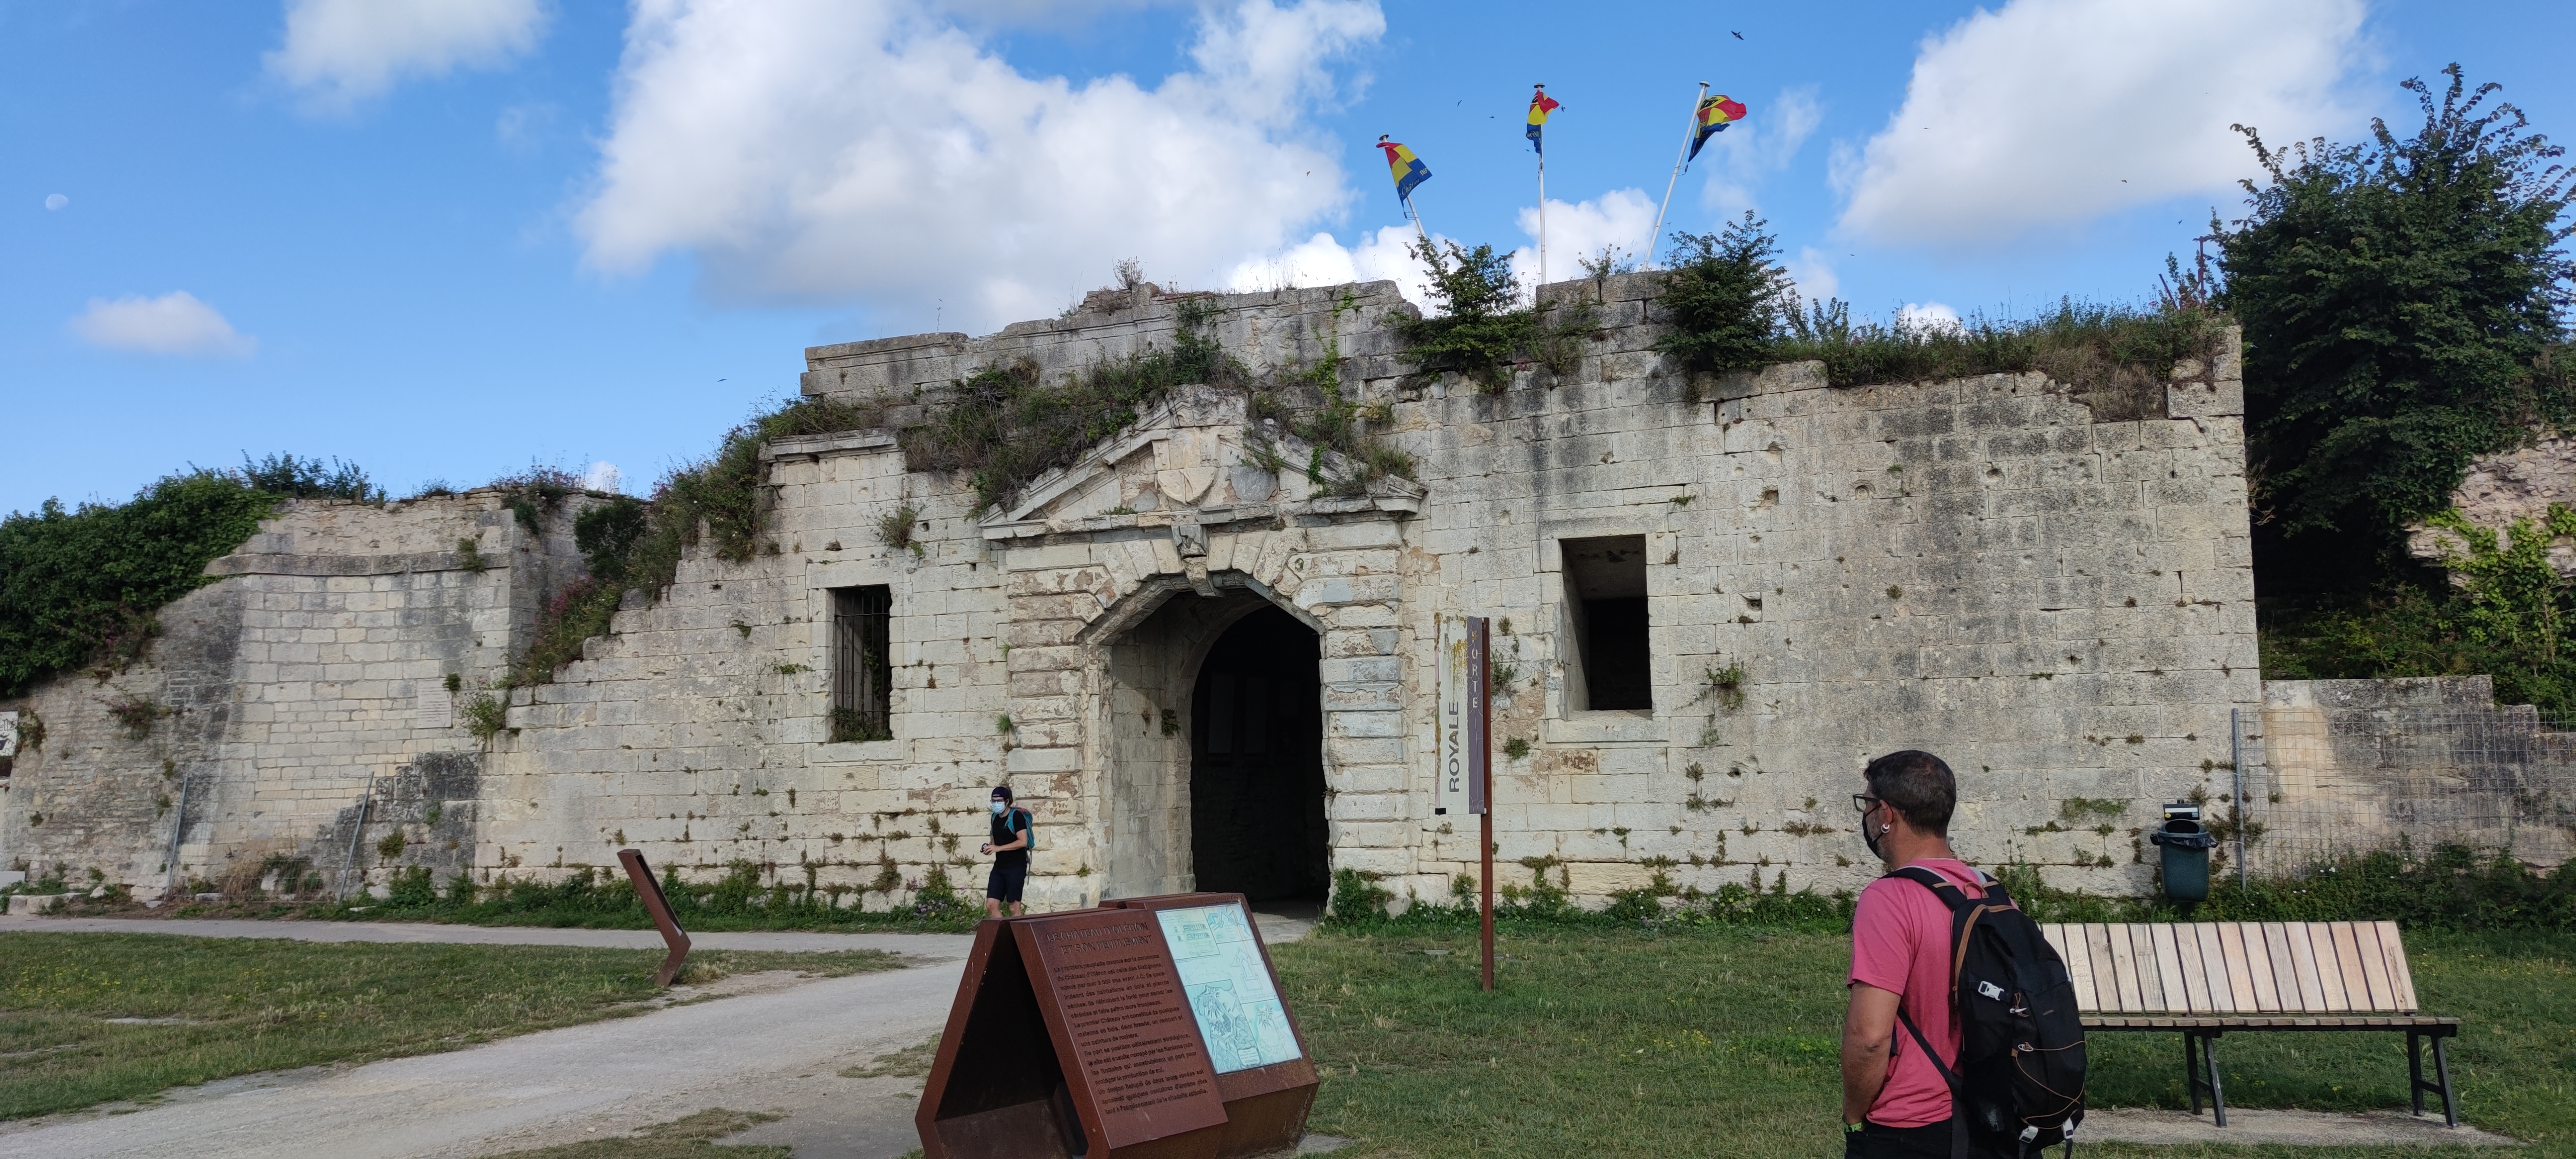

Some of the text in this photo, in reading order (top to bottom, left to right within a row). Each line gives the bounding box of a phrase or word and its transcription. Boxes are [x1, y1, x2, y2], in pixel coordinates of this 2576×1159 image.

[1449, 700, 1459, 792] ROYALE
[1047, 922, 1148, 942] LE CHÂTEAU D'OLÉRON
[1061, 935, 1152, 955] ET SON PEUPLEMENT
[1081, 1019, 1100, 1028] premier
[1130, 1011, 1152, 1019] constitué
[1110, 1044, 1131, 1053] position
[1122, 1070, 1148, 1080] production
